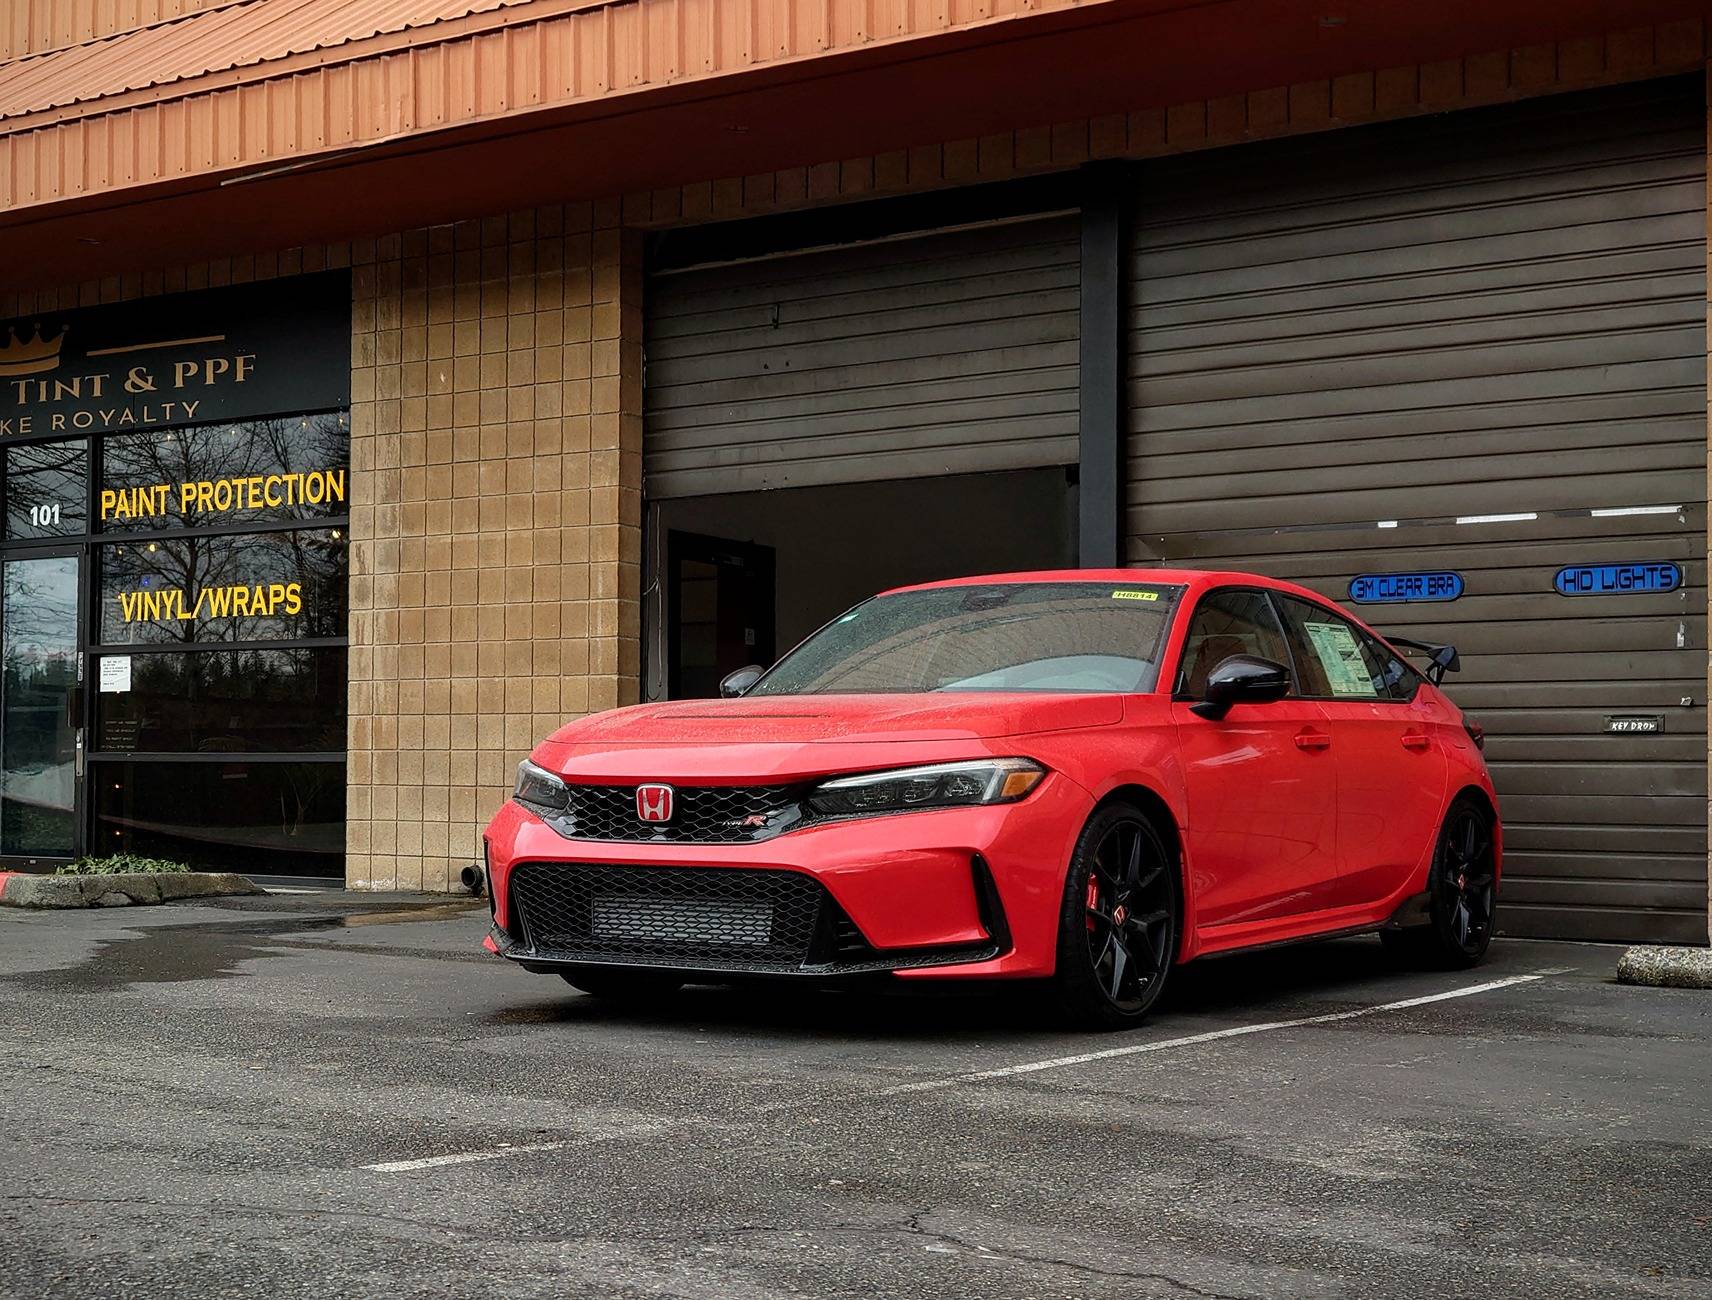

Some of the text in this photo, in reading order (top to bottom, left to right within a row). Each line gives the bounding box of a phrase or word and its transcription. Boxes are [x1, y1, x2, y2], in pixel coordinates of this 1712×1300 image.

[10, 354, 257, 405] TINT & PPF
[52, 400, 201, 431] ROYALTY
[101, 469, 345, 520] PAINT PROTECTION
[30, 503, 60, 526] 101
[1379, 577, 1423, 597] CLEAR
[1427, 576, 1455, 595] BRA
[1563, 566, 1673, 592] HID LIGHTS
[120, 583, 302, 622] VINYL/WRAPS
[1611, 721, 1629, 731] KEY
